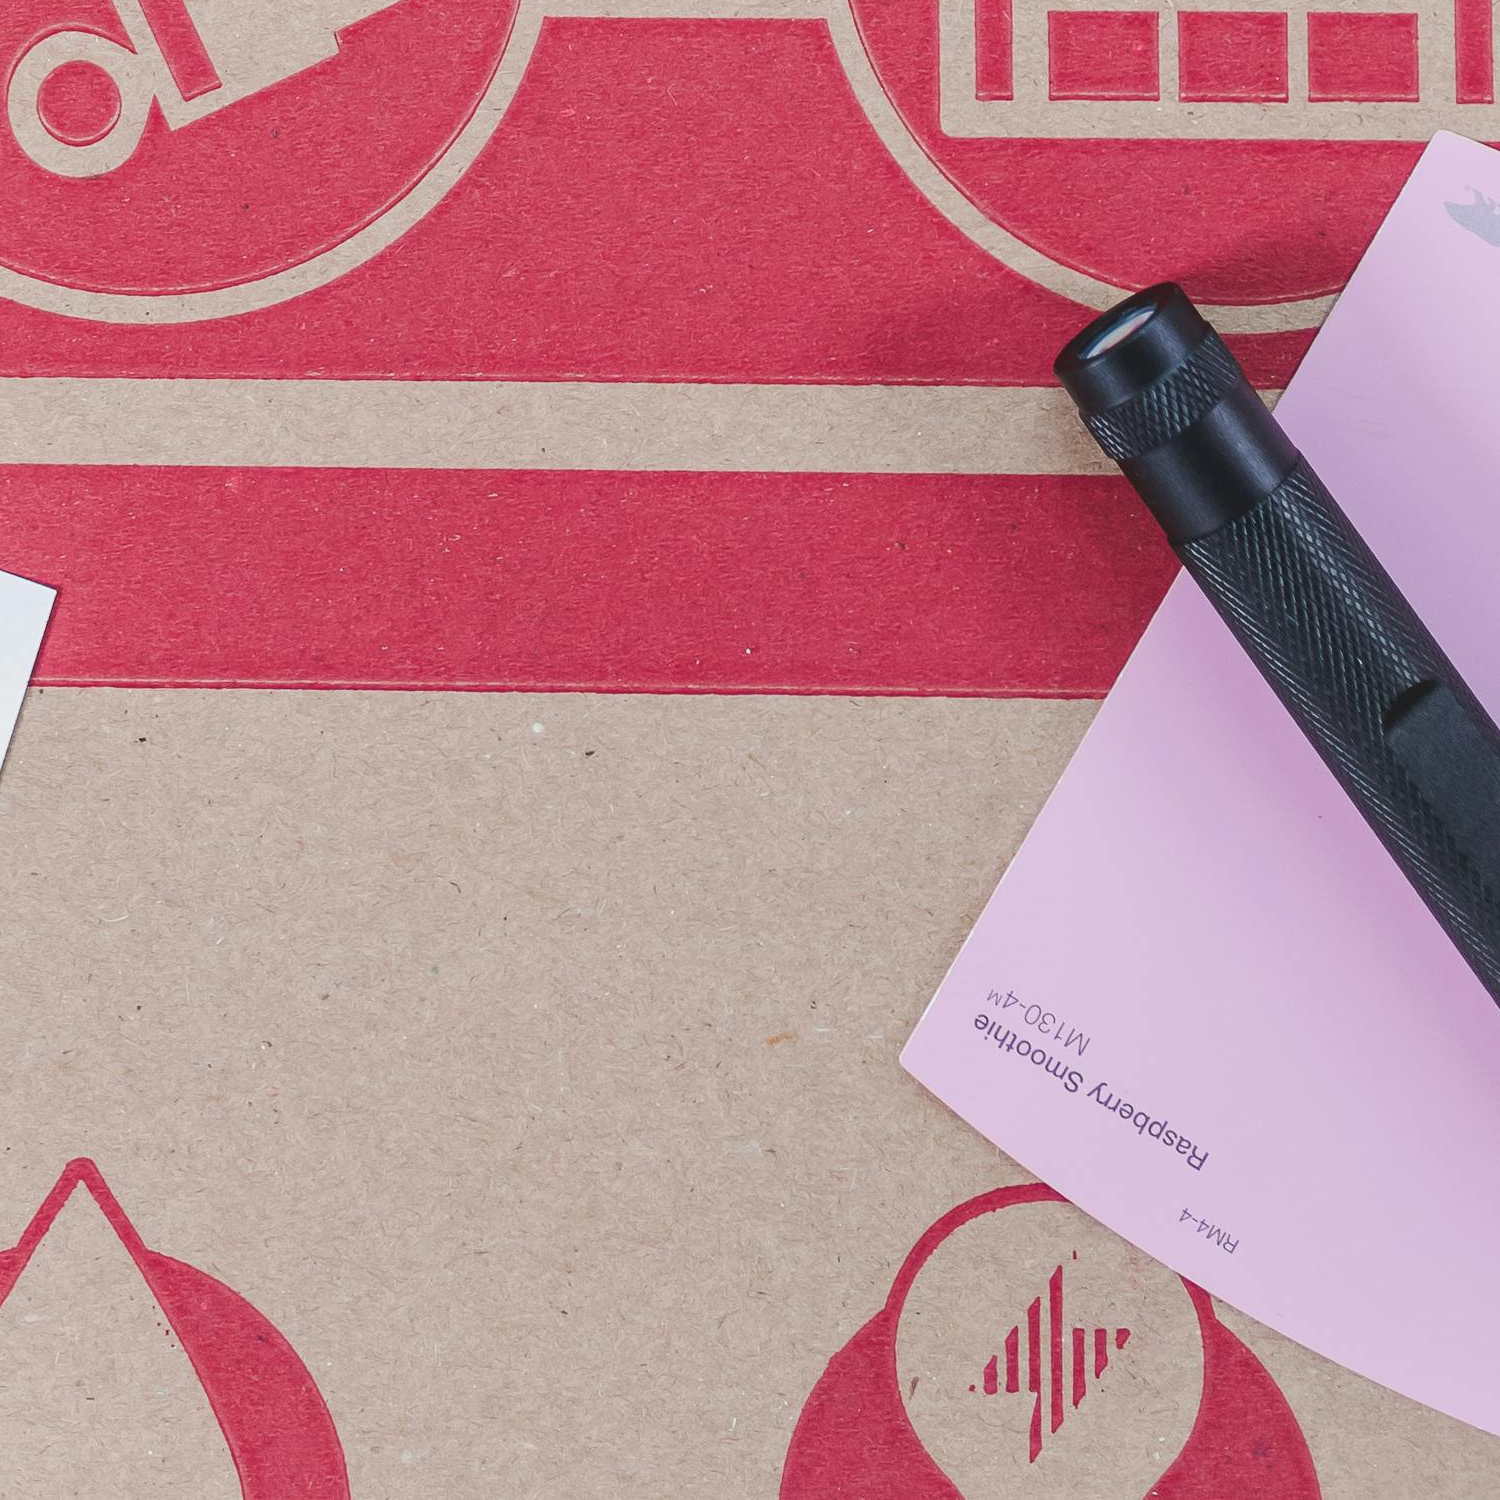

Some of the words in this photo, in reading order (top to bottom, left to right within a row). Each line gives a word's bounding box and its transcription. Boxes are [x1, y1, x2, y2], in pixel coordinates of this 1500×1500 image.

[975, 1015, 1083, 1092] Smoothie
[1087, 1083, 1208, 1170] Raspberry
[1178, 1207, 1240, 1254] RM4-4
